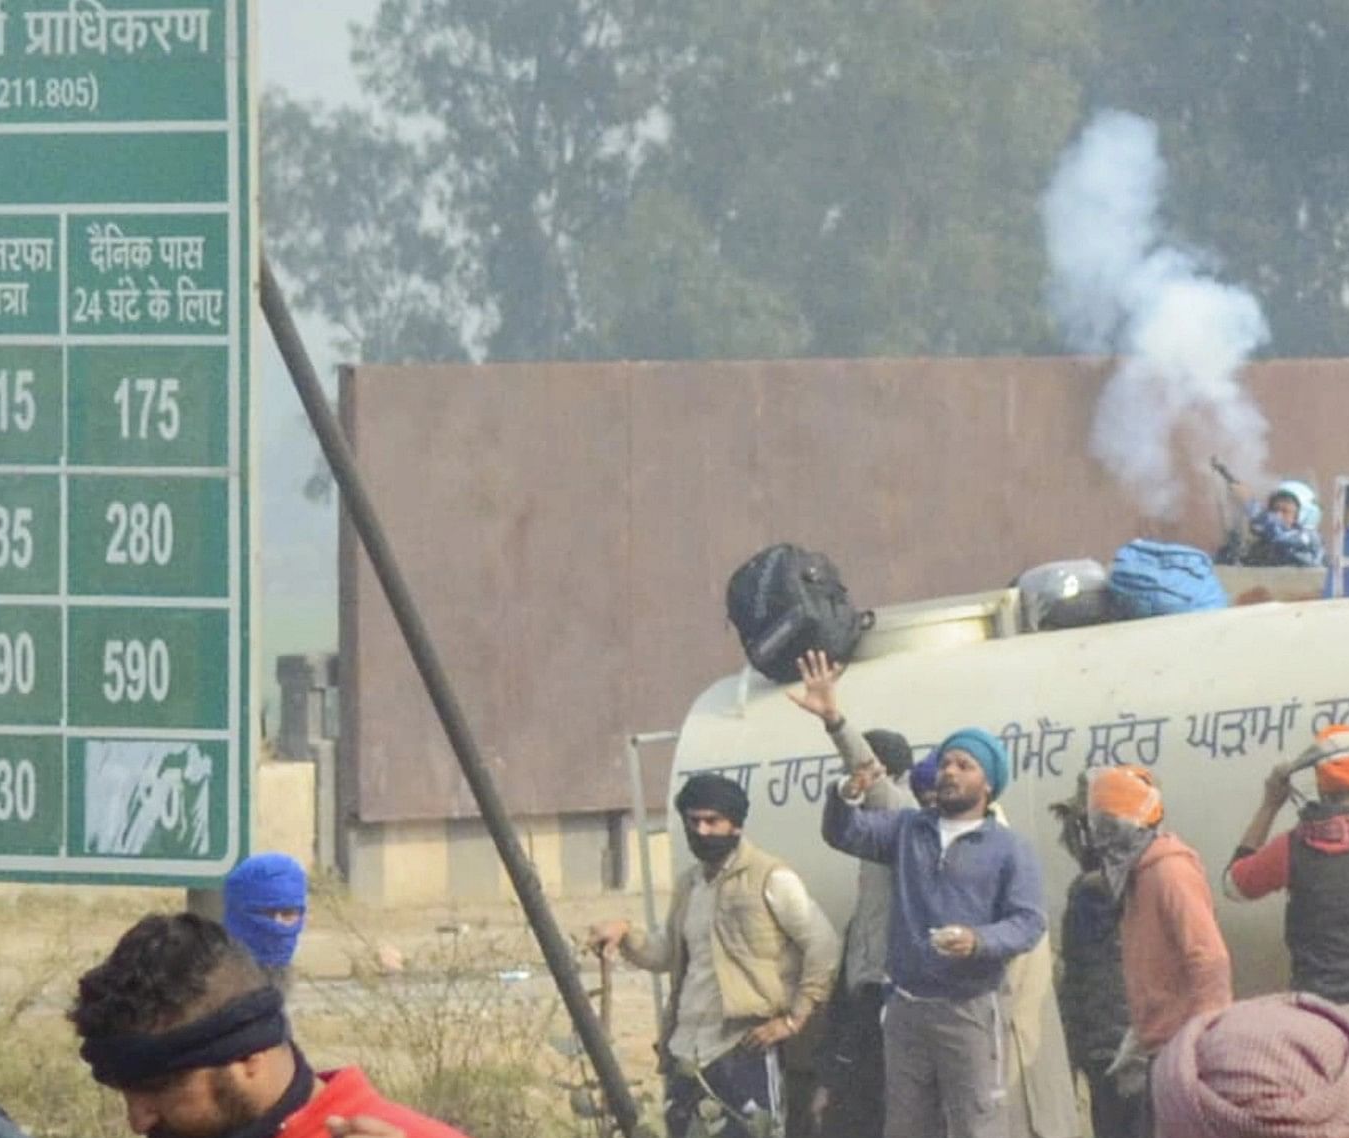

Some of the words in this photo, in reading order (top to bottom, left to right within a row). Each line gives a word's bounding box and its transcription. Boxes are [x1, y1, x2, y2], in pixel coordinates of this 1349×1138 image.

[23, 0, 210, 55] प्राधिकरण
[86, 222, 153, 272] दैनिक
[158, 236, 206, 270] पास
[73, 287, 103, 323] 24
[106, 276, 141, 323] घंटे
[148, 276, 171, 322] के
[177, 276, 224, 326] लिए
[114, 377, 180, 440] 175
[106, 501, 173, 565] 280
[104, 638, 169, 702] 590
